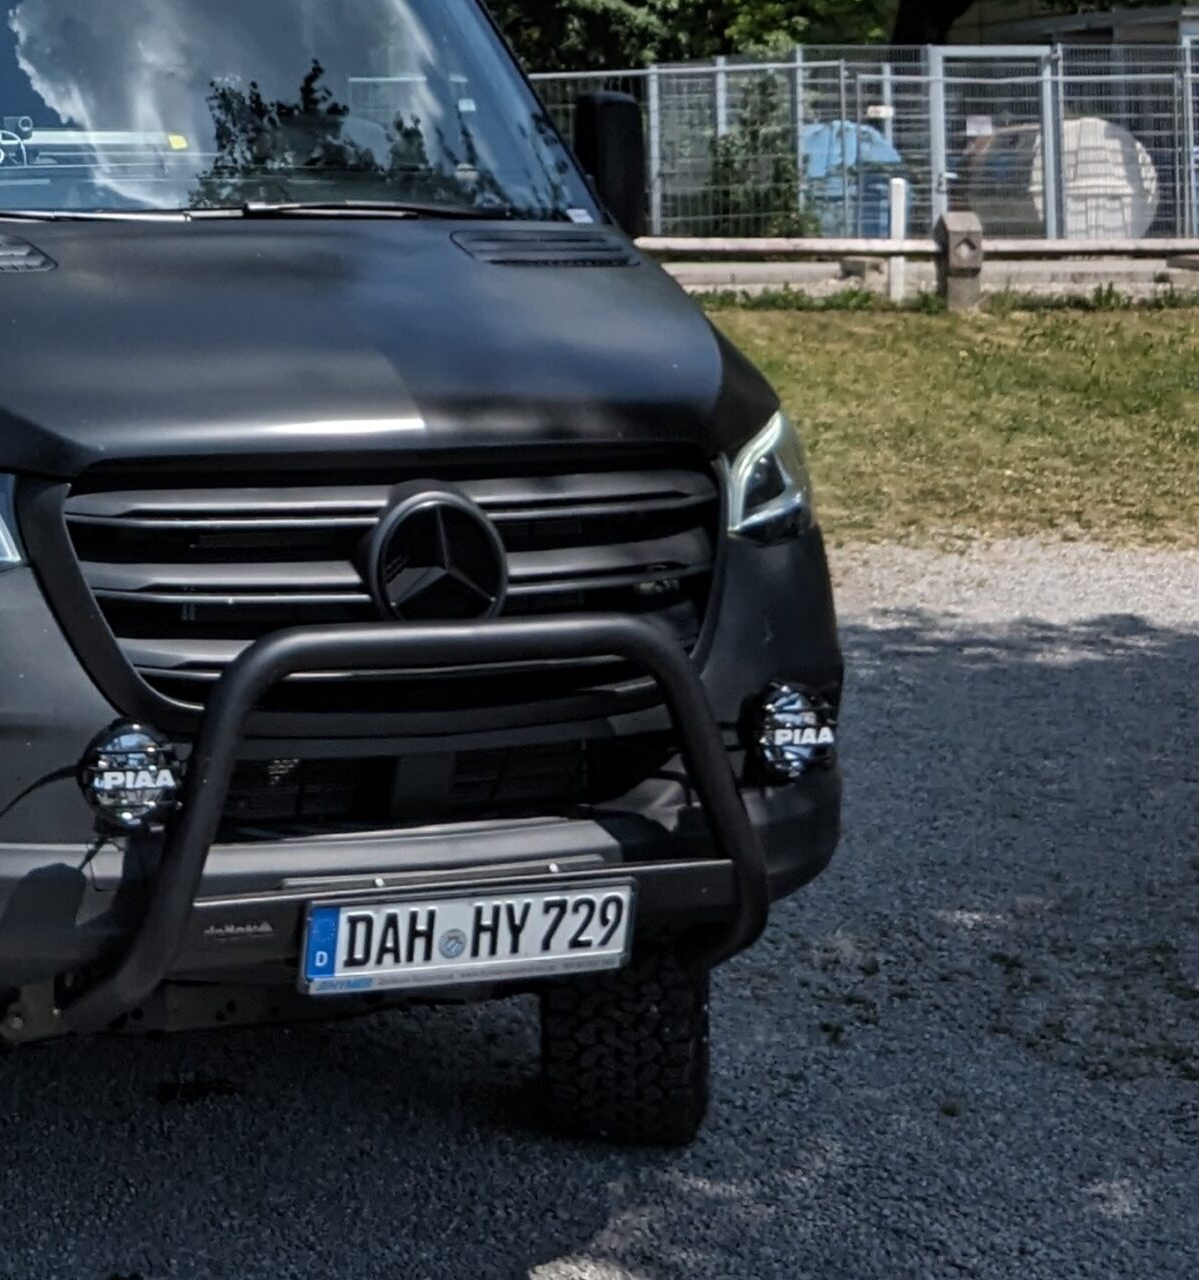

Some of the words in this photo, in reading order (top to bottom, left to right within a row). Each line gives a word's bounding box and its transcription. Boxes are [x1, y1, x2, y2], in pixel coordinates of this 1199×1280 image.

[774, 726, 834, 746] PIAA
[104, 769, 176, 790] PIAA
[343, 907, 437, 967] DAH
[470, 900, 532, 957] HY
[541, 894, 623, 951] 729
[315, 951, 328, 967] D
